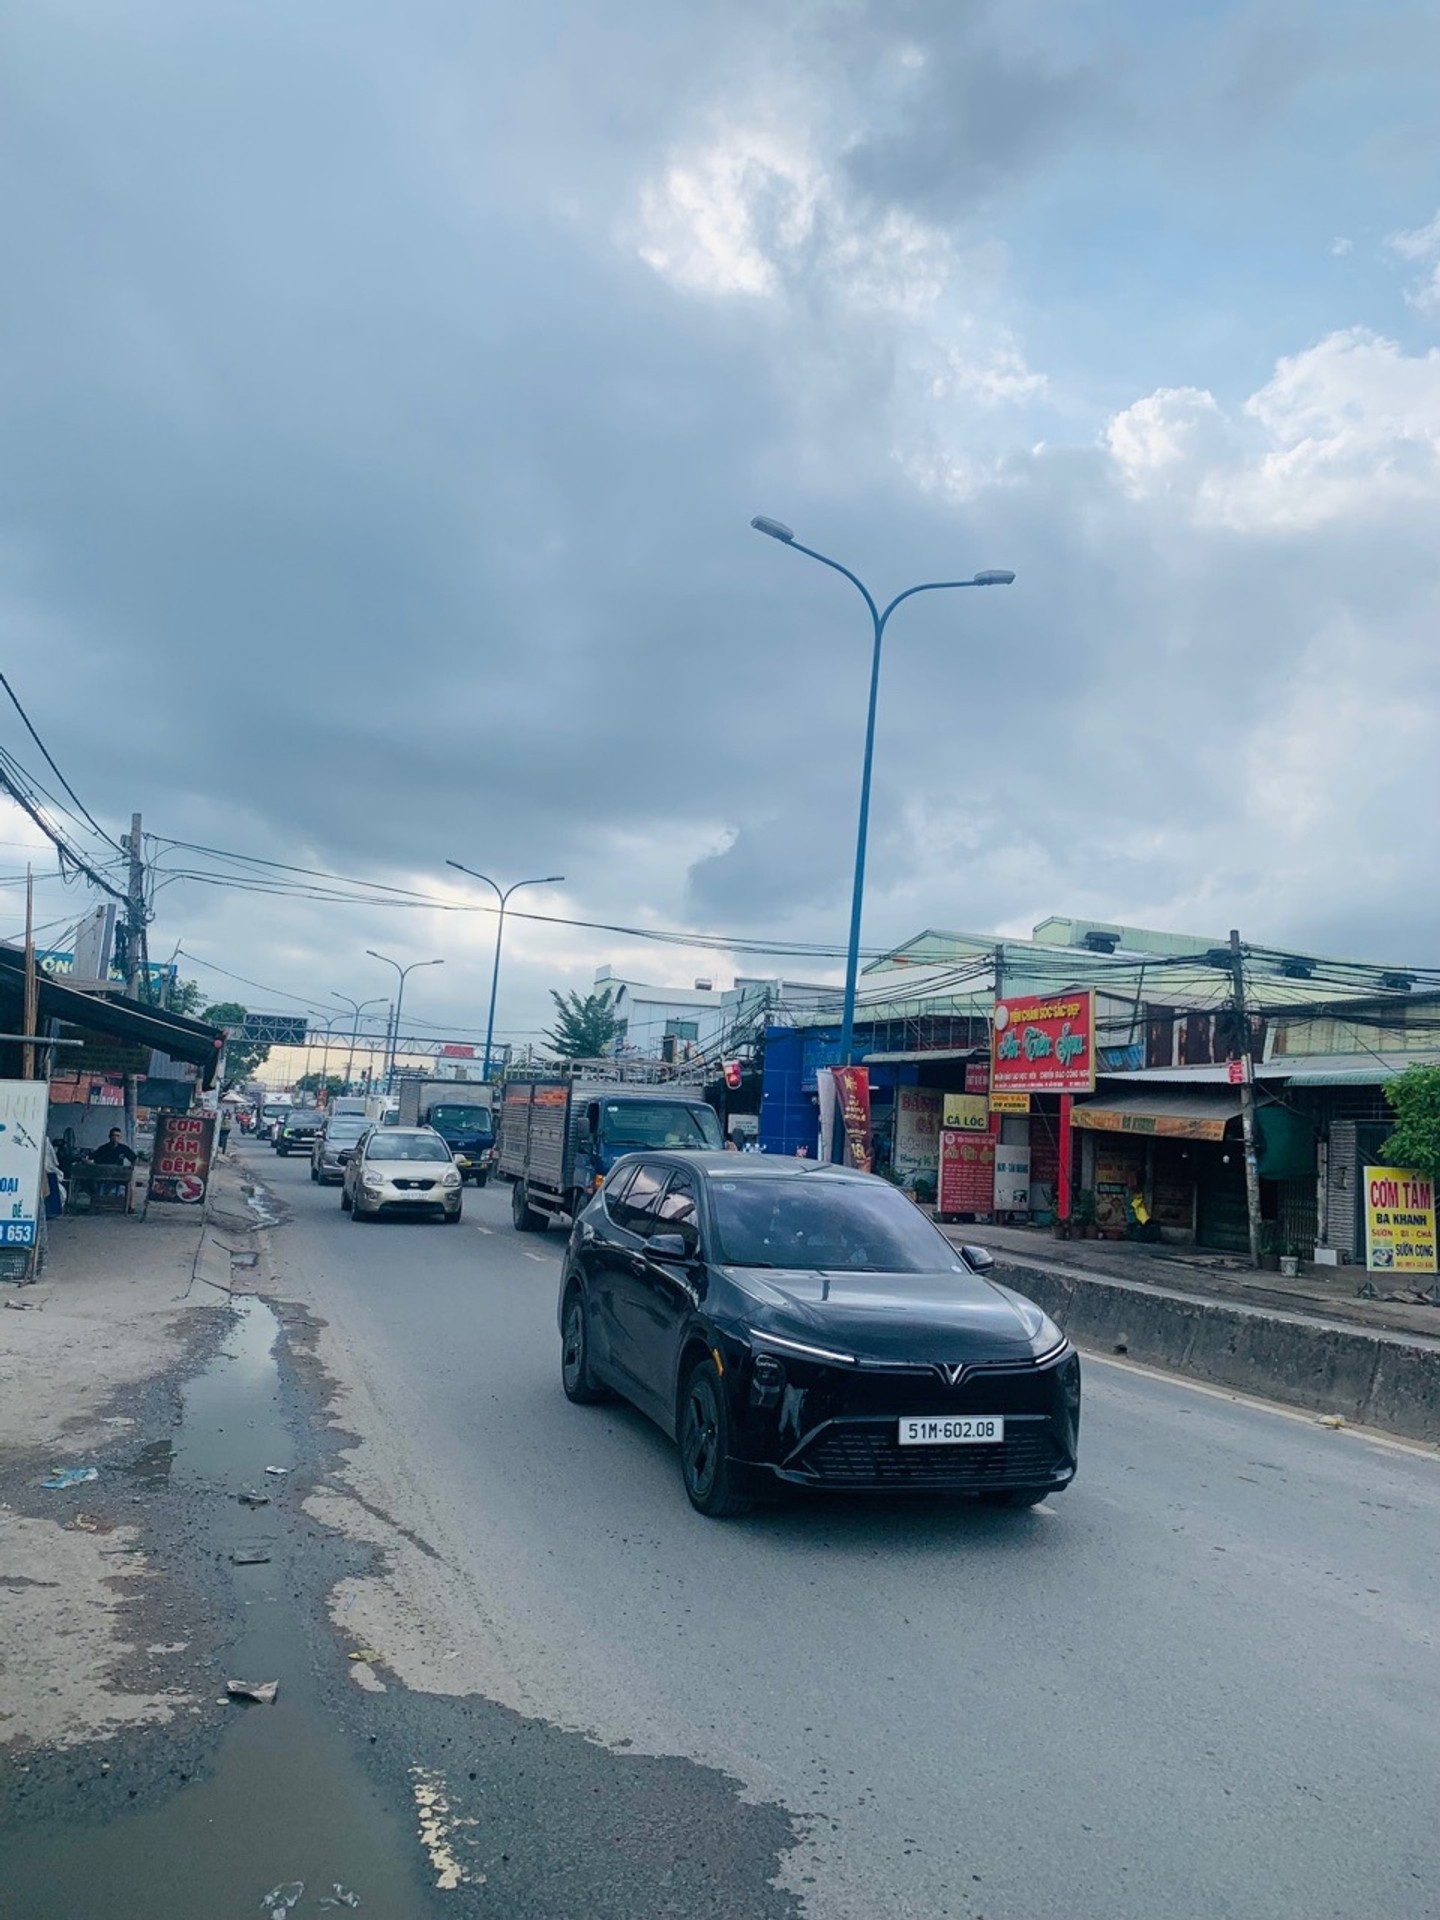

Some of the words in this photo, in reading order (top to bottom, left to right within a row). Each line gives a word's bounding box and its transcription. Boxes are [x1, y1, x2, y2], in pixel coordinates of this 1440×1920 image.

[1371, 1177, 1399, 1208] CƠM
[1402, 1171, 1431, 1209] TẤM
[1376, 1213, 1390, 1224] BA
[1393, 1213, 1427, 1226] KHANH
[7, 1225, 31, 1242] 653
